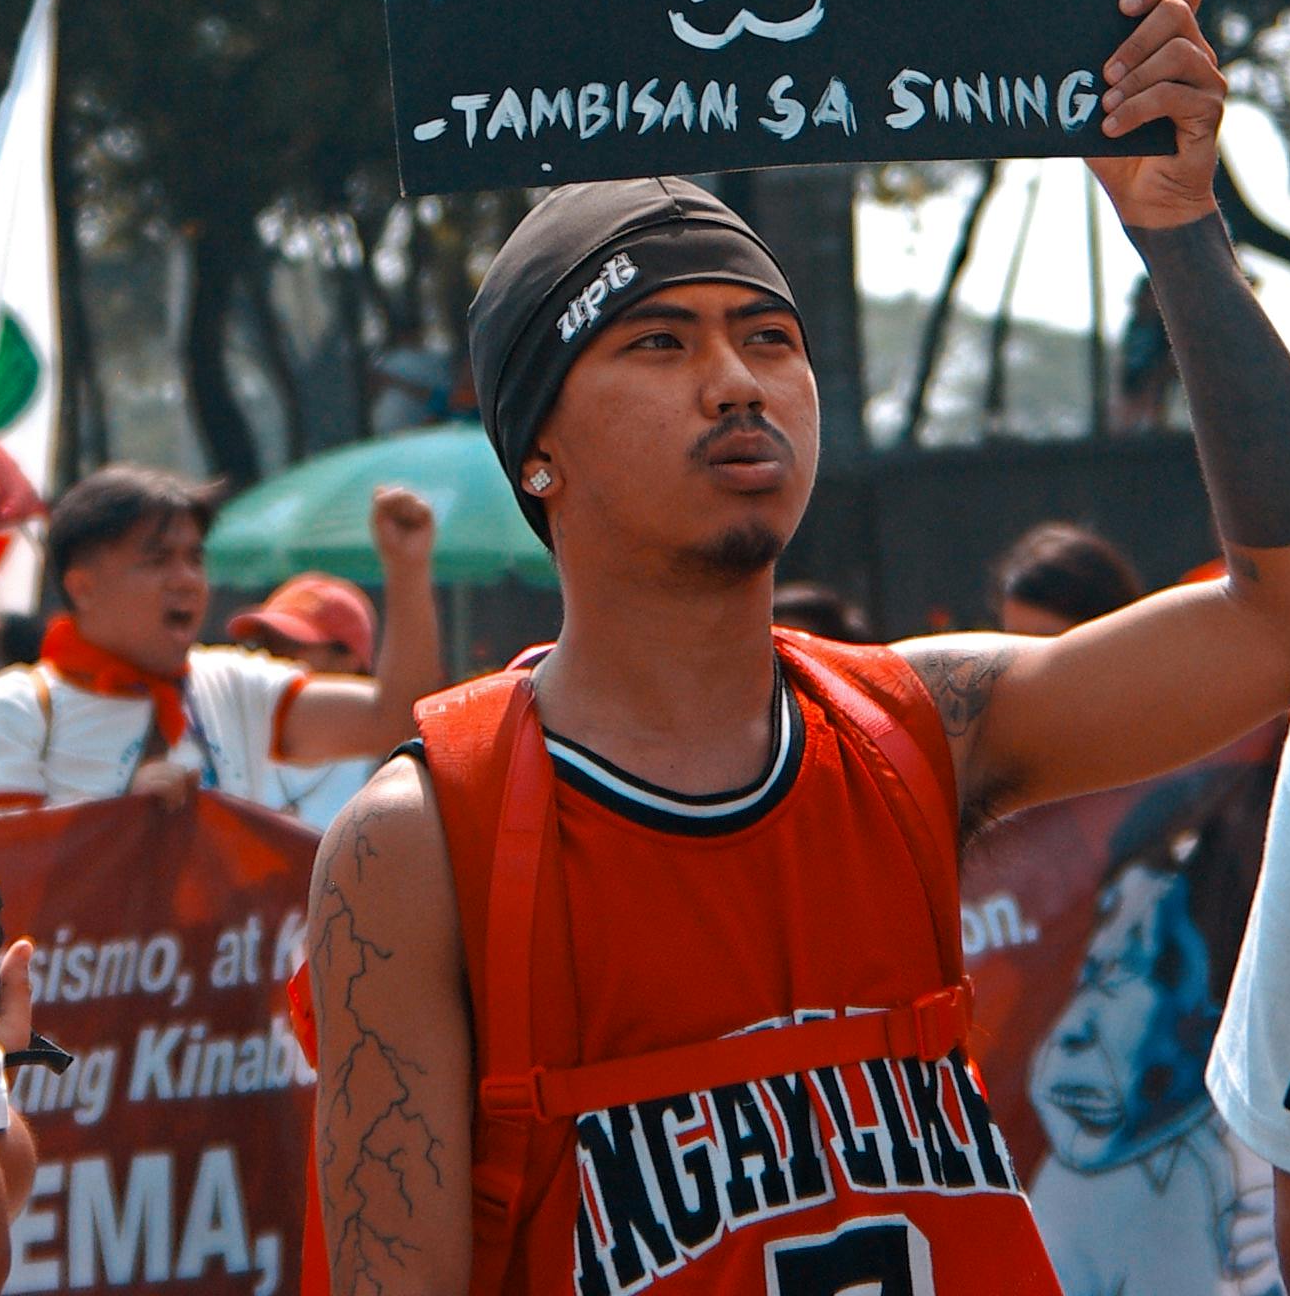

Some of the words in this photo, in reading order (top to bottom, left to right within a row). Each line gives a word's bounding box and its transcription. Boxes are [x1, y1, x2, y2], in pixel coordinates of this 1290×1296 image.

[758, 74, 857, 140] SA
[885, 68, 1099, 134] SINING
[212, 915, 263, 988] at
